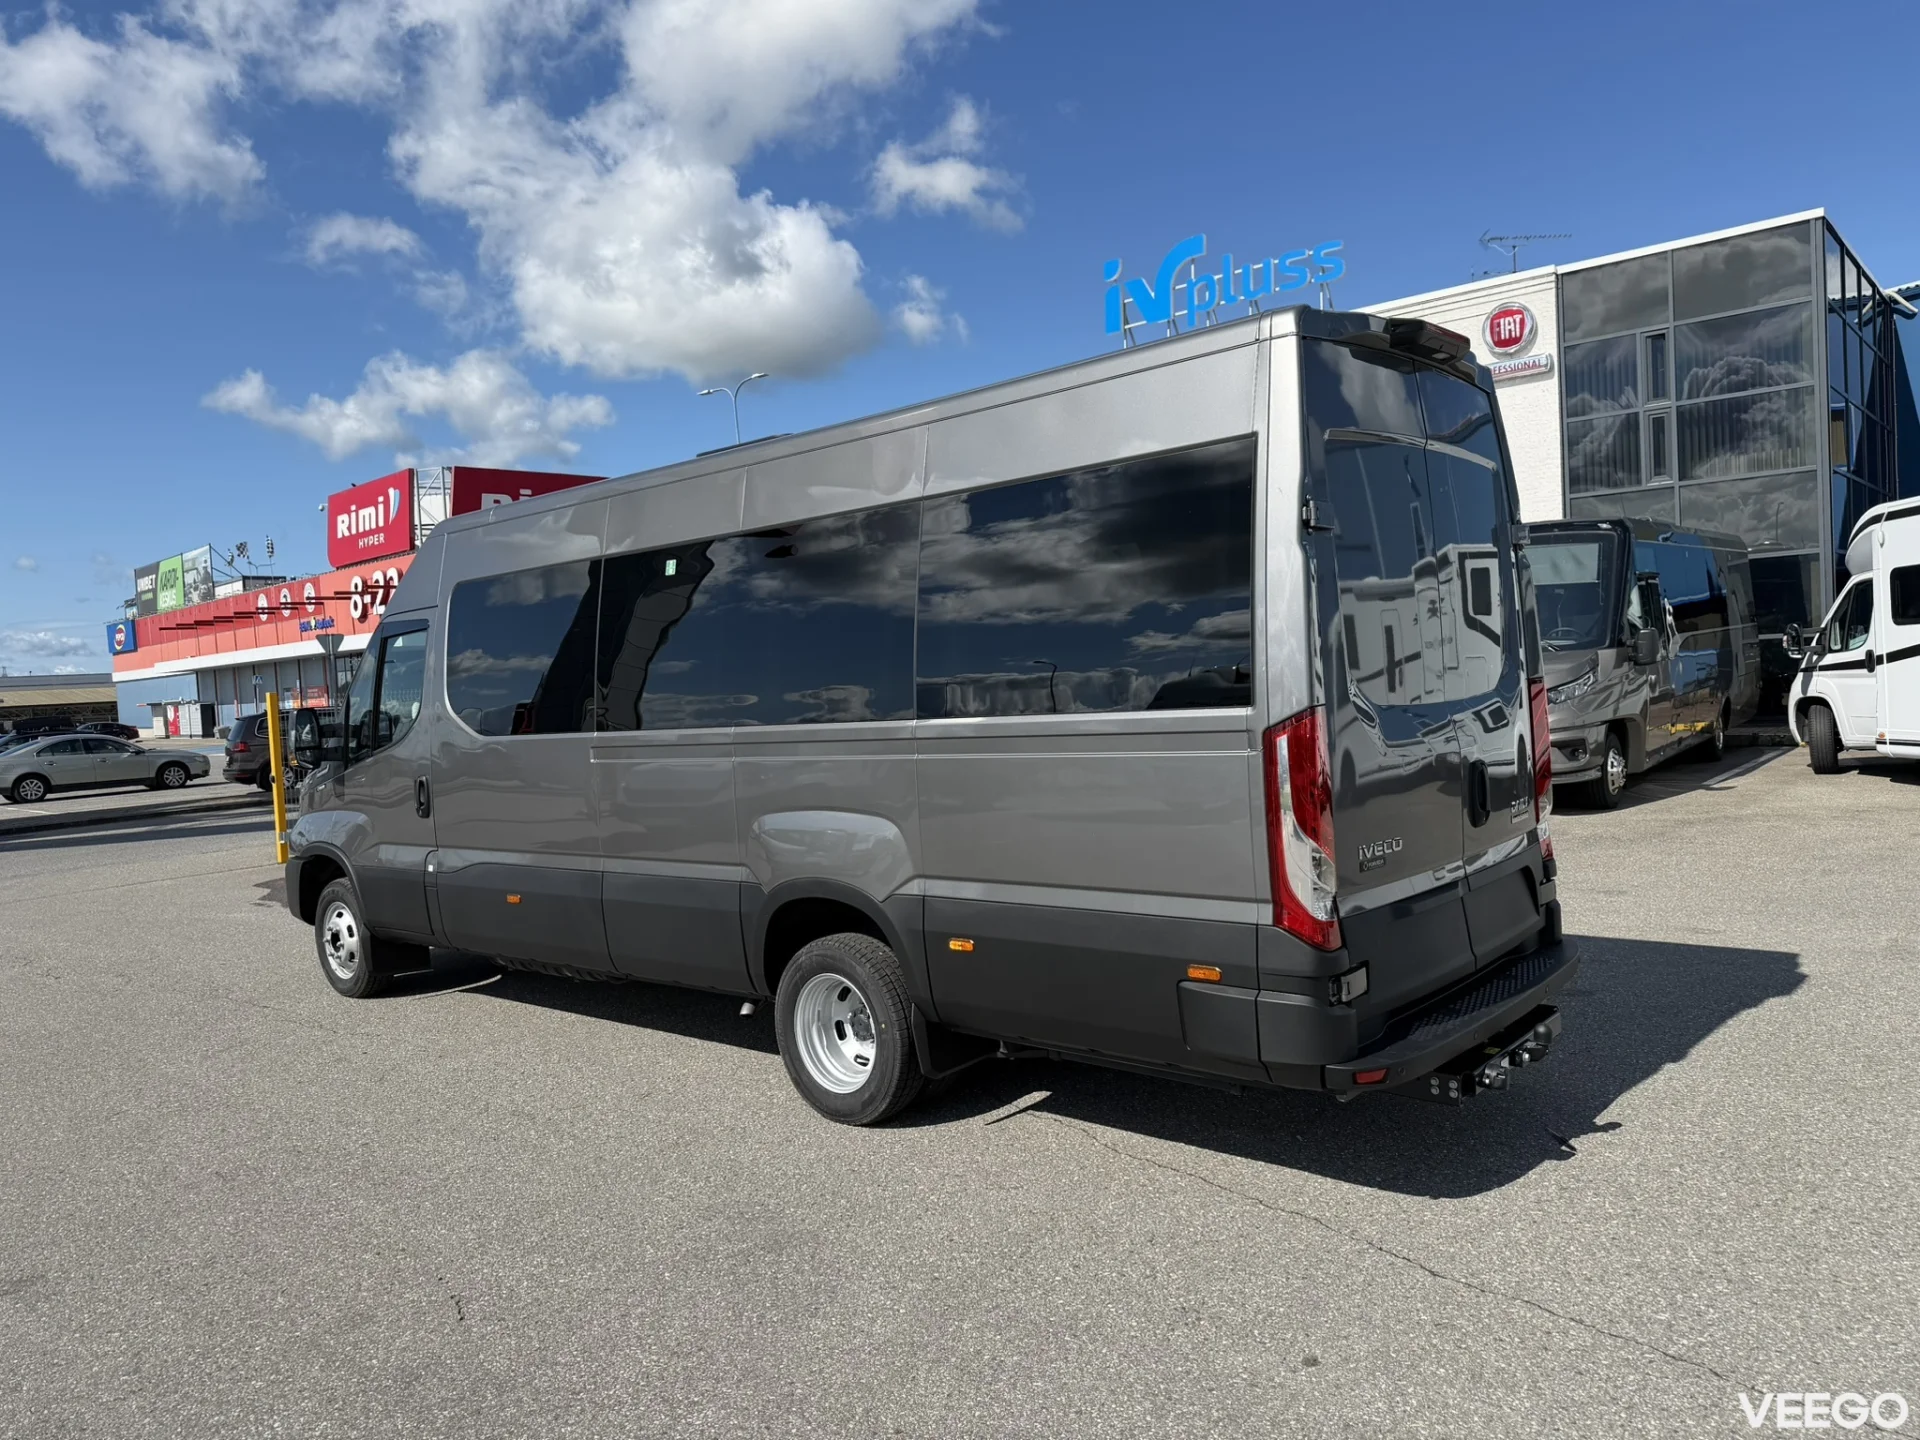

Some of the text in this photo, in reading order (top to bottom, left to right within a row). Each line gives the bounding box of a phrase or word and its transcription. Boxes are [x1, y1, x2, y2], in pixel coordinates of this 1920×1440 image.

[1493, 314, 1523, 342] FIAT
[1492, 358, 1543, 374] FESSIONAL
[336, 495, 384, 539] Rimi
[358, 533, 385, 549] HYPER
[1359, 837, 1403, 860] IVECO
